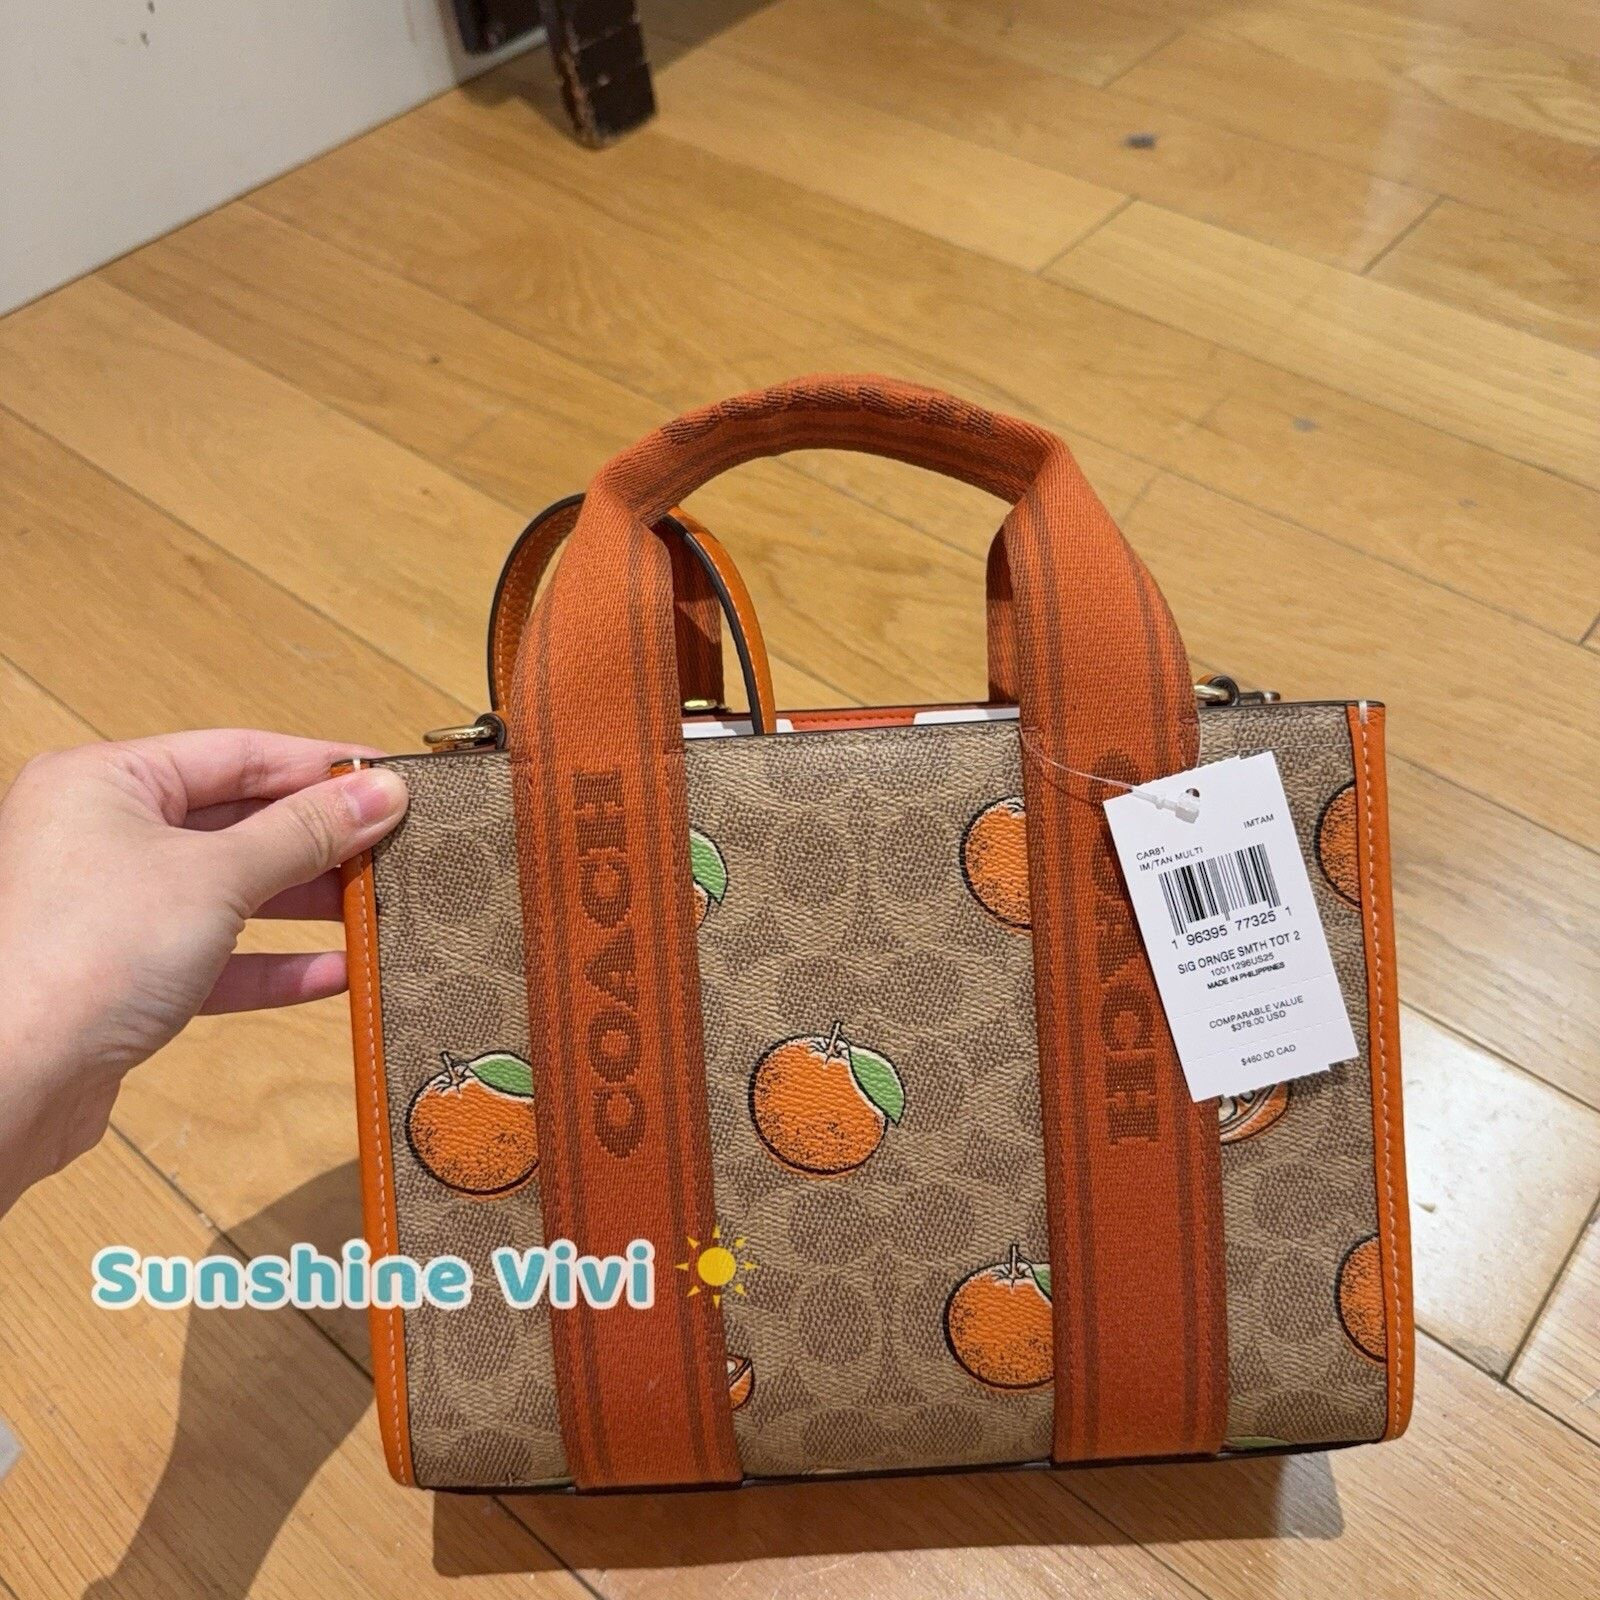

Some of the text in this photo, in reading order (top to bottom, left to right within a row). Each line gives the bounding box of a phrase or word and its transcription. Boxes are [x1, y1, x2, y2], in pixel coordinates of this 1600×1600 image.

[1243, 813, 1275, 829] IMTAM
[1139, 846, 1203, 872] IM/TAN MULTI
[1172, 906, 1292, 950] 1 96395 77325 1
[573, 771, 646, 1159] COACH
[1177, 930, 1301, 975] SIG ORNGE SMTH TOT 2
[1207, 961, 1286, 990] MADE IN PHILIPPINES
[1209, 995, 1304, 1029] COMPARABLE VALUE
[1230, 1010, 1287, 1032] $378.00 USD
[1276, 1044, 1297, 1056] CAD
